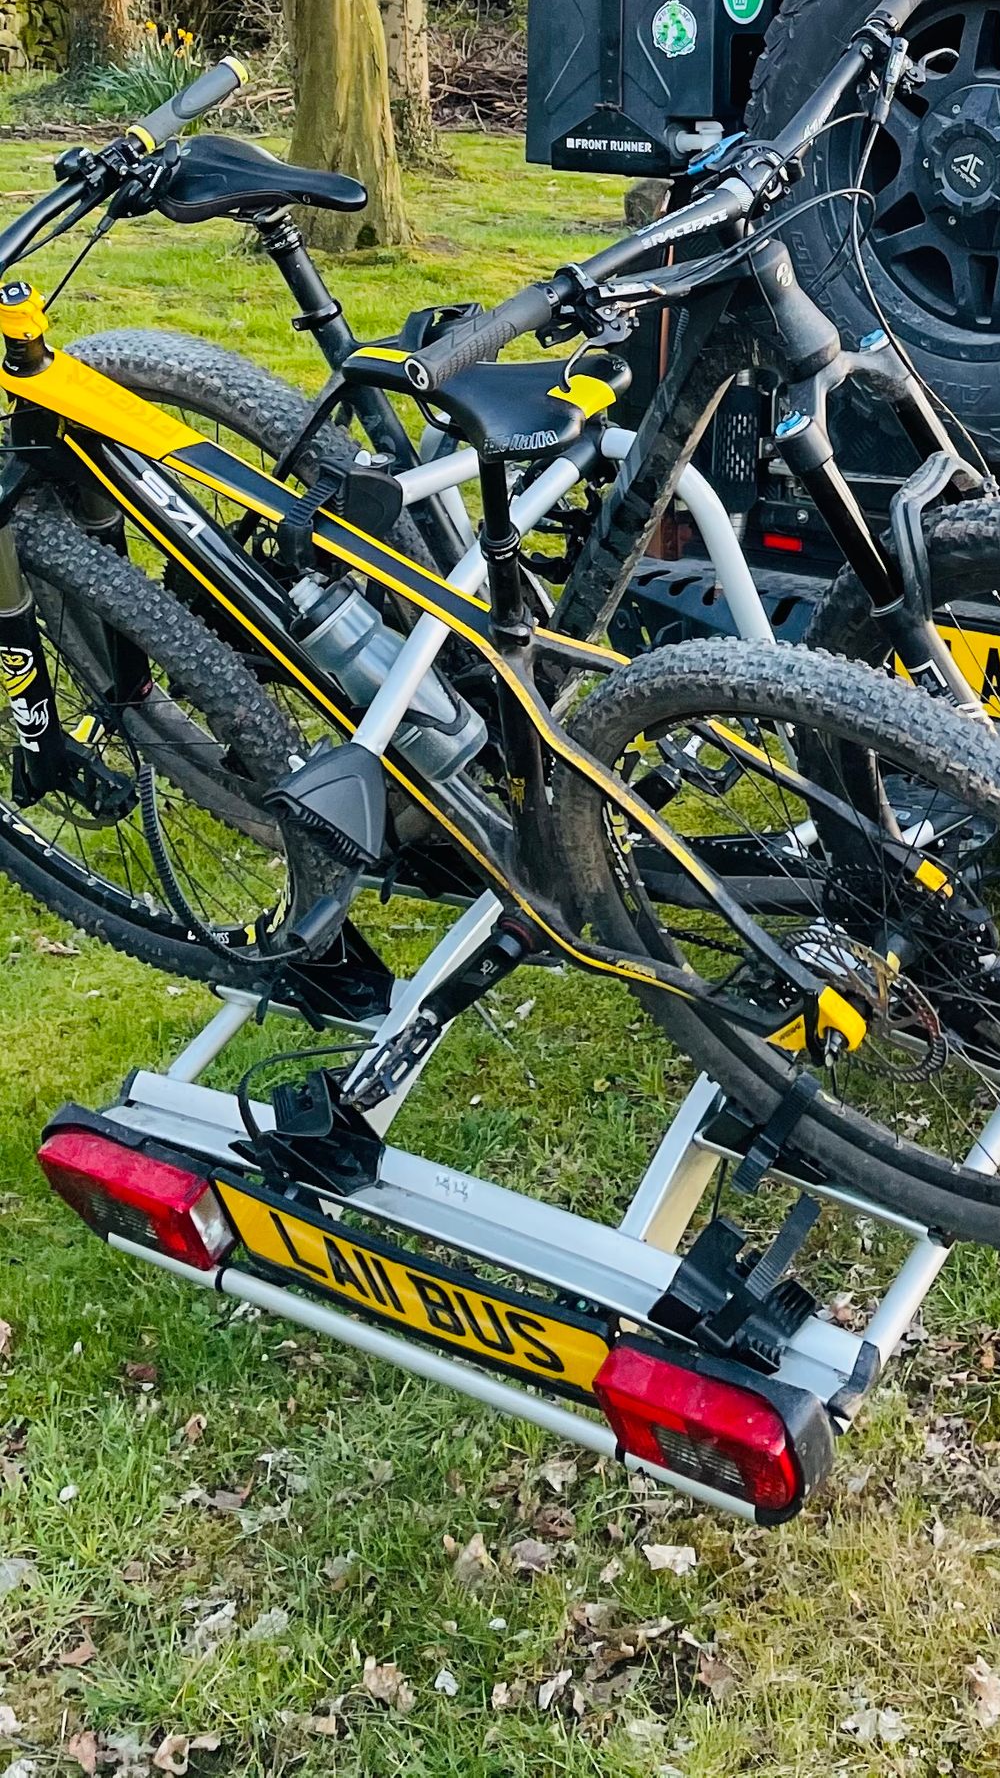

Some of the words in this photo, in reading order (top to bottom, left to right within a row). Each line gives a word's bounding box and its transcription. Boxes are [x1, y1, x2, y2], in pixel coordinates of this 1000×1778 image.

[575, 138, 608, 151] FRONT
[610, 140, 652, 153] RUNNER
[405, 1271, 566, 1373] BUS
